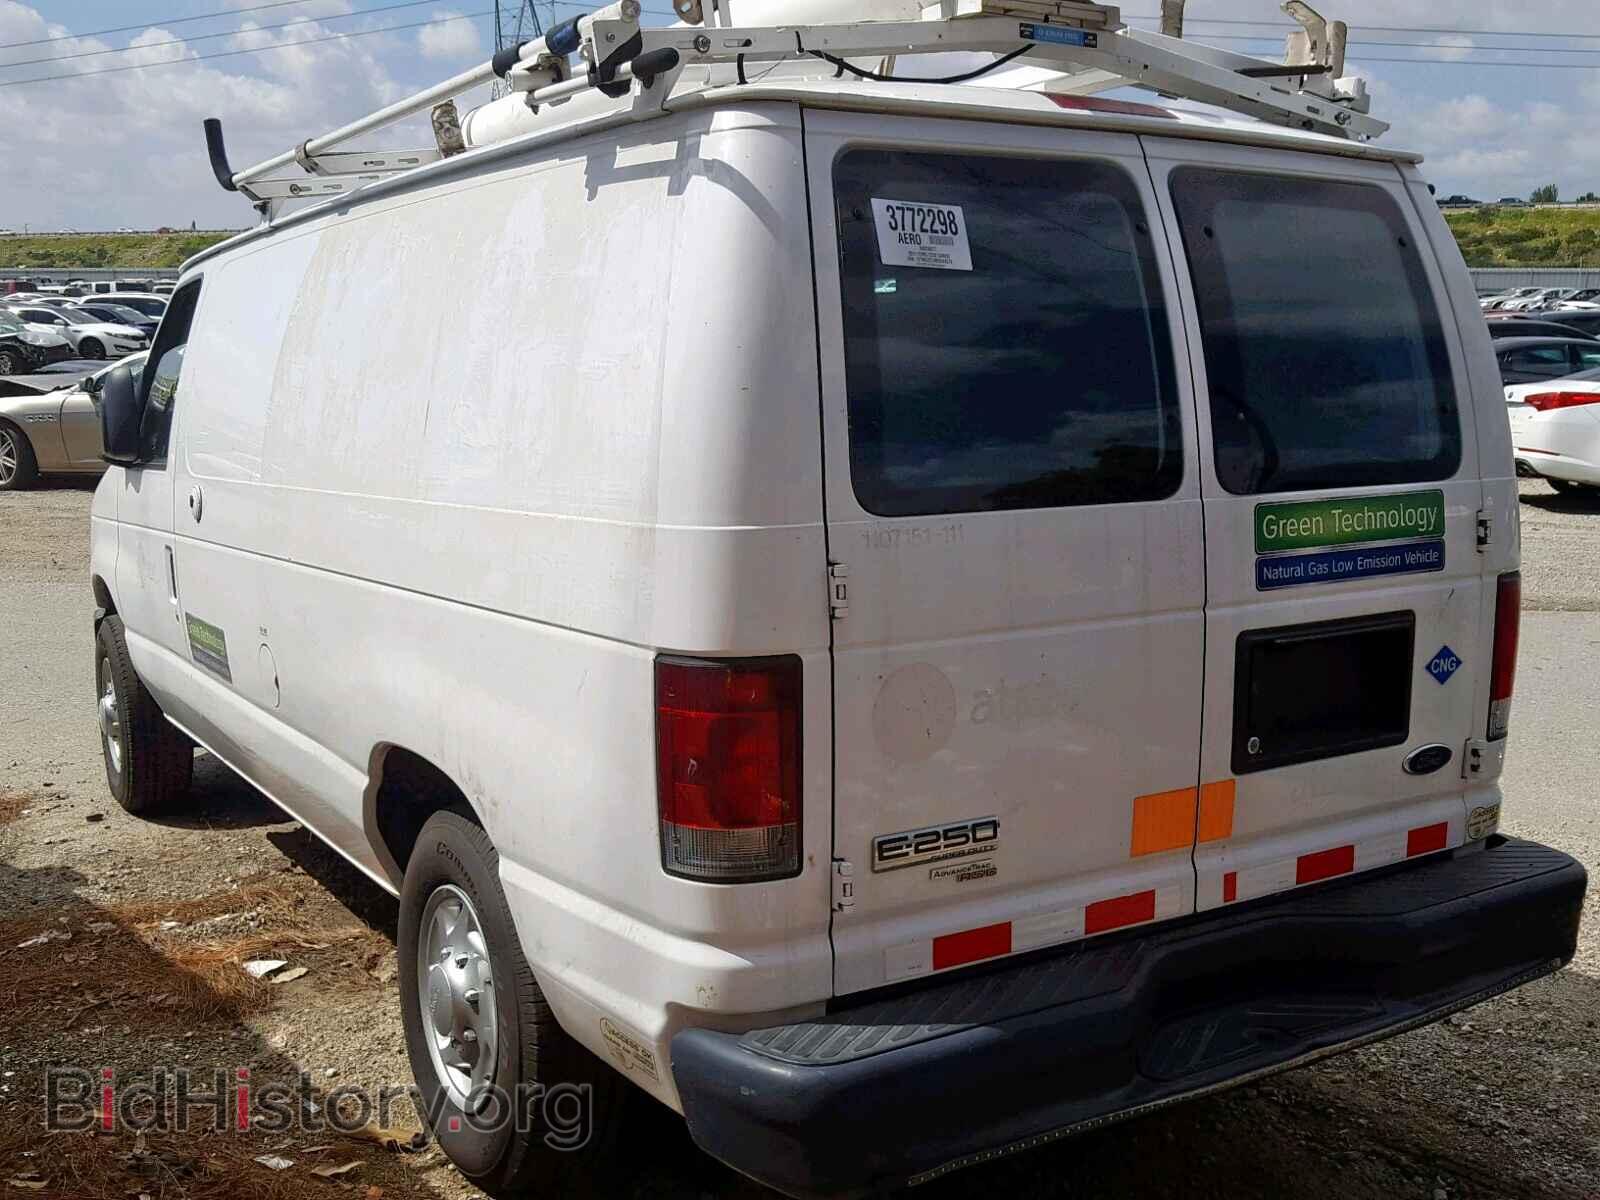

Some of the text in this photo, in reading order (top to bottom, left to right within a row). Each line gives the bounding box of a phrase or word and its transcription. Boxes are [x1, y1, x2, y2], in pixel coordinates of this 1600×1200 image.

[886, 204, 959, 236] 3772298
[898, 232, 922, 246] AERO
[1263, 503, 1438, 540] Green Technology
[1263, 549, 1440, 581] Natural Gas Low Emission Vehicle
[1431, 656, 1458, 674] CNG
[877, 820, 998, 861] E-250
